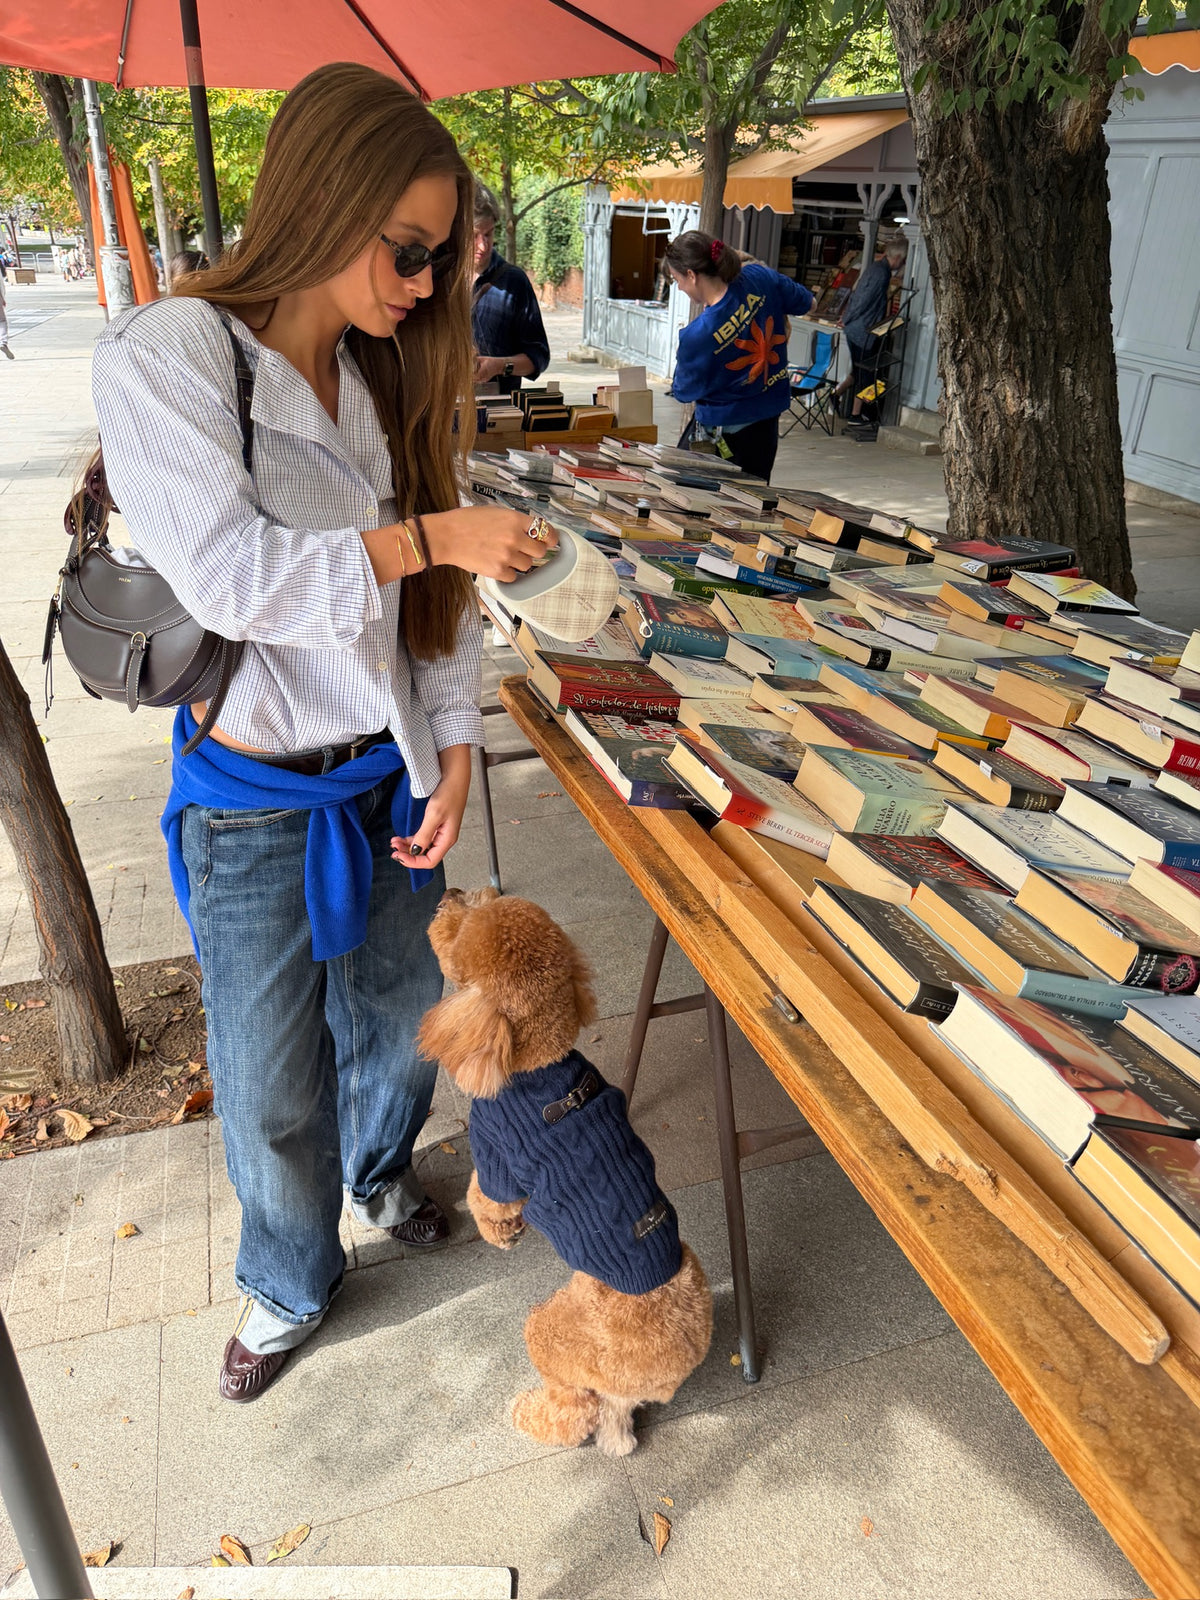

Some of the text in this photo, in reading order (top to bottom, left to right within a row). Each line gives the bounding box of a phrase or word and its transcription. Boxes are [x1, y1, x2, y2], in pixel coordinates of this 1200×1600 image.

[713, 293, 762, 344] IBIZA
[586, 695, 627, 706] contador
[629, 699, 643, 709] de
[1177, 754, 1197, 769] REINA
[748, 811, 766, 824] STEVE
[766, 819, 785, 831] BERRY
[793, 831, 815, 844] TERCER
[871, 807, 887, 833] JULIA
[966, 895, 1057, 961] STALINGRADO
[1034, 989, 1067, 1000] STALINGRADO
[1076, 996, 1096, 1006] BATALLA
[1062, 1011, 1198, 1123] IMPRIMATUR
